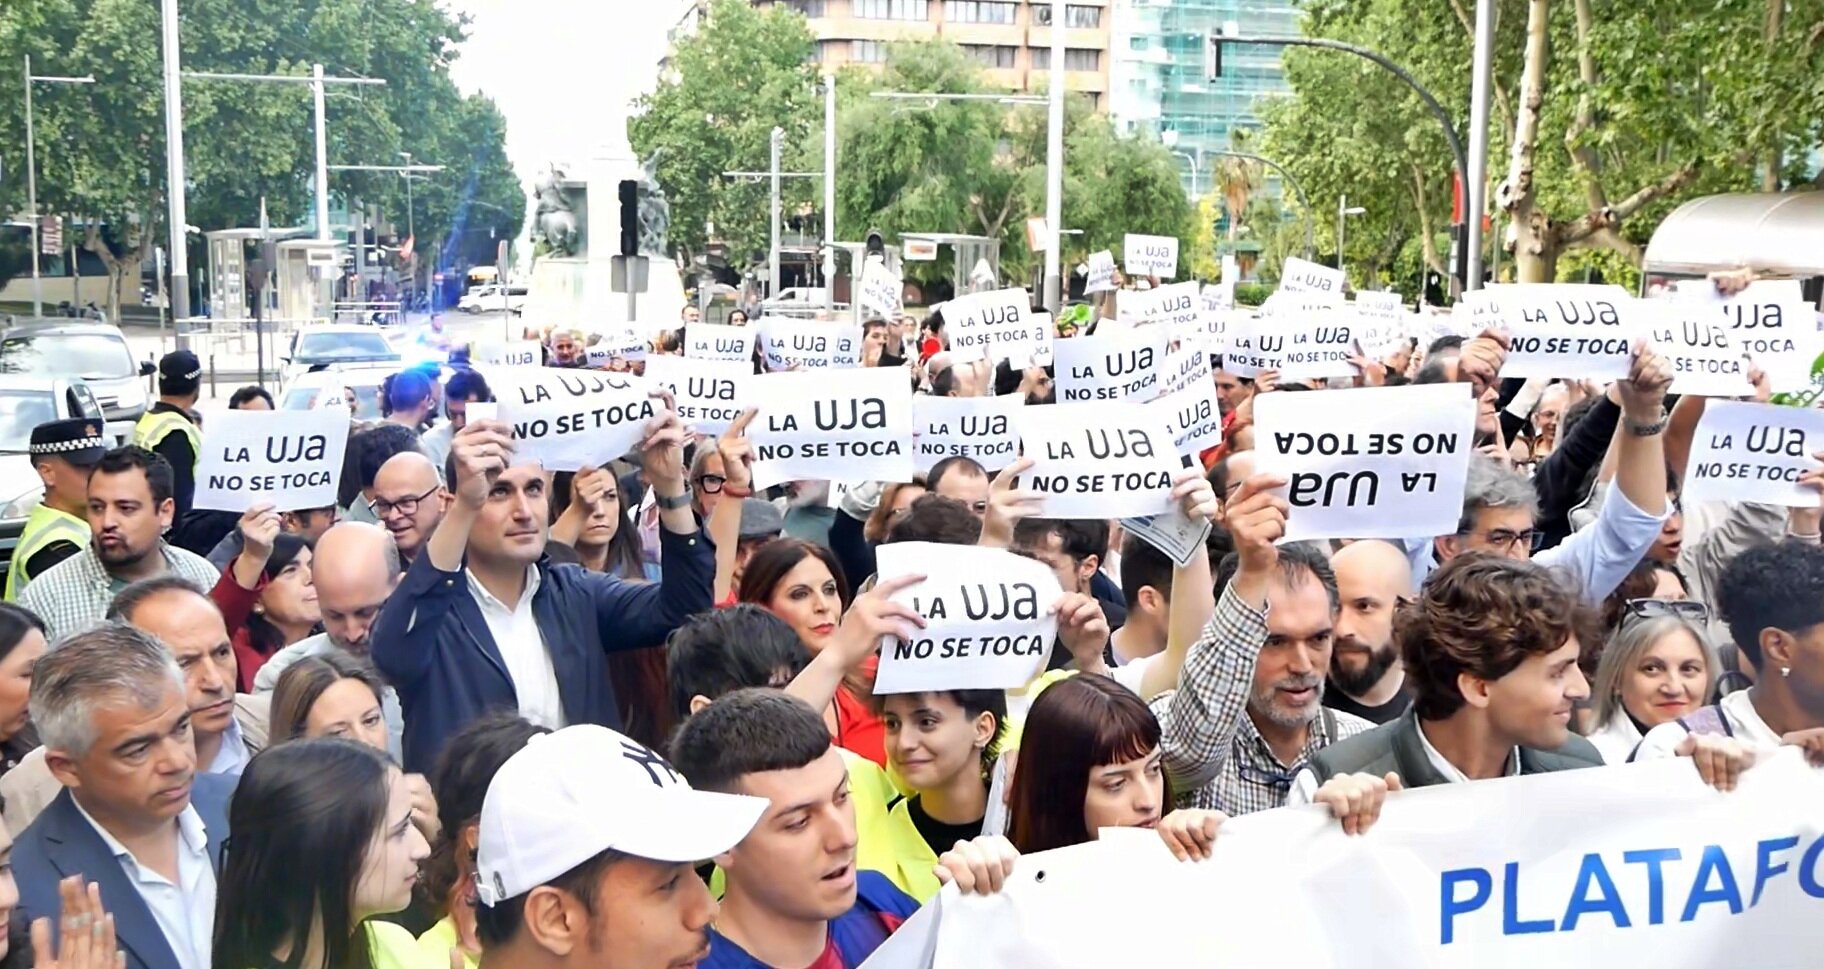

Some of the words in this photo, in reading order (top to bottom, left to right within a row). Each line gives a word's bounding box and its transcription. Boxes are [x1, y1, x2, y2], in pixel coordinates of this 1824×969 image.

[960, 317, 975, 328] LA
[1172, 312, 1198, 324] TOCA
[1523, 308, 1548, 323] LA
[771, 338, 785, 348] LA
[956, 336, 974, 347] NO
[977, 333, 991, 345] SE
[994, 329, 1028, 343] TOCA
[1235, 338, 1251, 349] LA
[1259, 335, 1284, 352] UJ
[1293, 333, 1307, 344] LA
[1653, 329, 1674, 343] LA
[620, 345, 644, 354] TOCA
[1508, 337, 1539, 353] NO
[1544, 337, 1573, 354] SE
[1577, 338, 1629, 355] TOCA
[1741, 339, 1795, 353] TOCA
[767, 352, 783, 364] NO
[802, 358, 828, 368] TOCA
[833, 355, 854, 365] OCA
[1228, 353, 1247, 365] NO
[1250, 357, 1265, 368] SE
[1287, 352, 1304, 363] NO
[1307, 351, 1320, 362] SE
[1322, 351, 1347, 362] TOC
[1675, 357, 1693, 372] SE
[1698, 359, 1741, 374] TOCA
[1072, 366, 1094, 379] LA
[1187, 367, 1208, 385] TOCA
[519, 384, 552, 404] LA
[1065, 389, 1091, 400] NO
[1097, 387, 1118, 399] SE
[1123, 373, 1157, 396] TOCA
[514, 419, 549, 440] NO
[556, 413, 585, 435] SE
[591, 400, 655, 428] TOCA
[677, 406, 696, 418] SE
[769, 414, 798, 432] LA
[930, 423, 949, 436] LA
[1187, 421, 1217, 442] TOCA
[759, 444, 794, 461] NO
[801, 443, 829, 458] SE
[836, 440, 901, 457] TOCA
[921, 443, 945, 456] NO
[950, 444, 969, 456] SE
[974, 440, 1014, 456] TOCA
[1047, 441, 1075, 460] LA
[1274, 432, 1359, 456] TOCA
[1367, 433, 1404, 456] SE
[1412, 432, 1458, 455] NO
[1711, 434, 1733, 450] LA
[222, 446, 250, 463] LA
[1695, 463, 1723, 479] NO
[1726, 463, 1749, 479] SE
[208, 474, 243, 491] NO
[249, 474, 274, 491] SE
[282, 470, 332, 489] TOCA
[1032, 475, 1069, 494] NO
[1075, 475, 1105, 493] SE
[1111, 471, 1171, 491] TOCA
[1401, 472, 1437, 493] LA
[913, 597, 947, 619] LA
[894, 638, 934, 660] NO
[940, 637, 972, 658] SE
[979, 635, 1043, 657] TOCA
